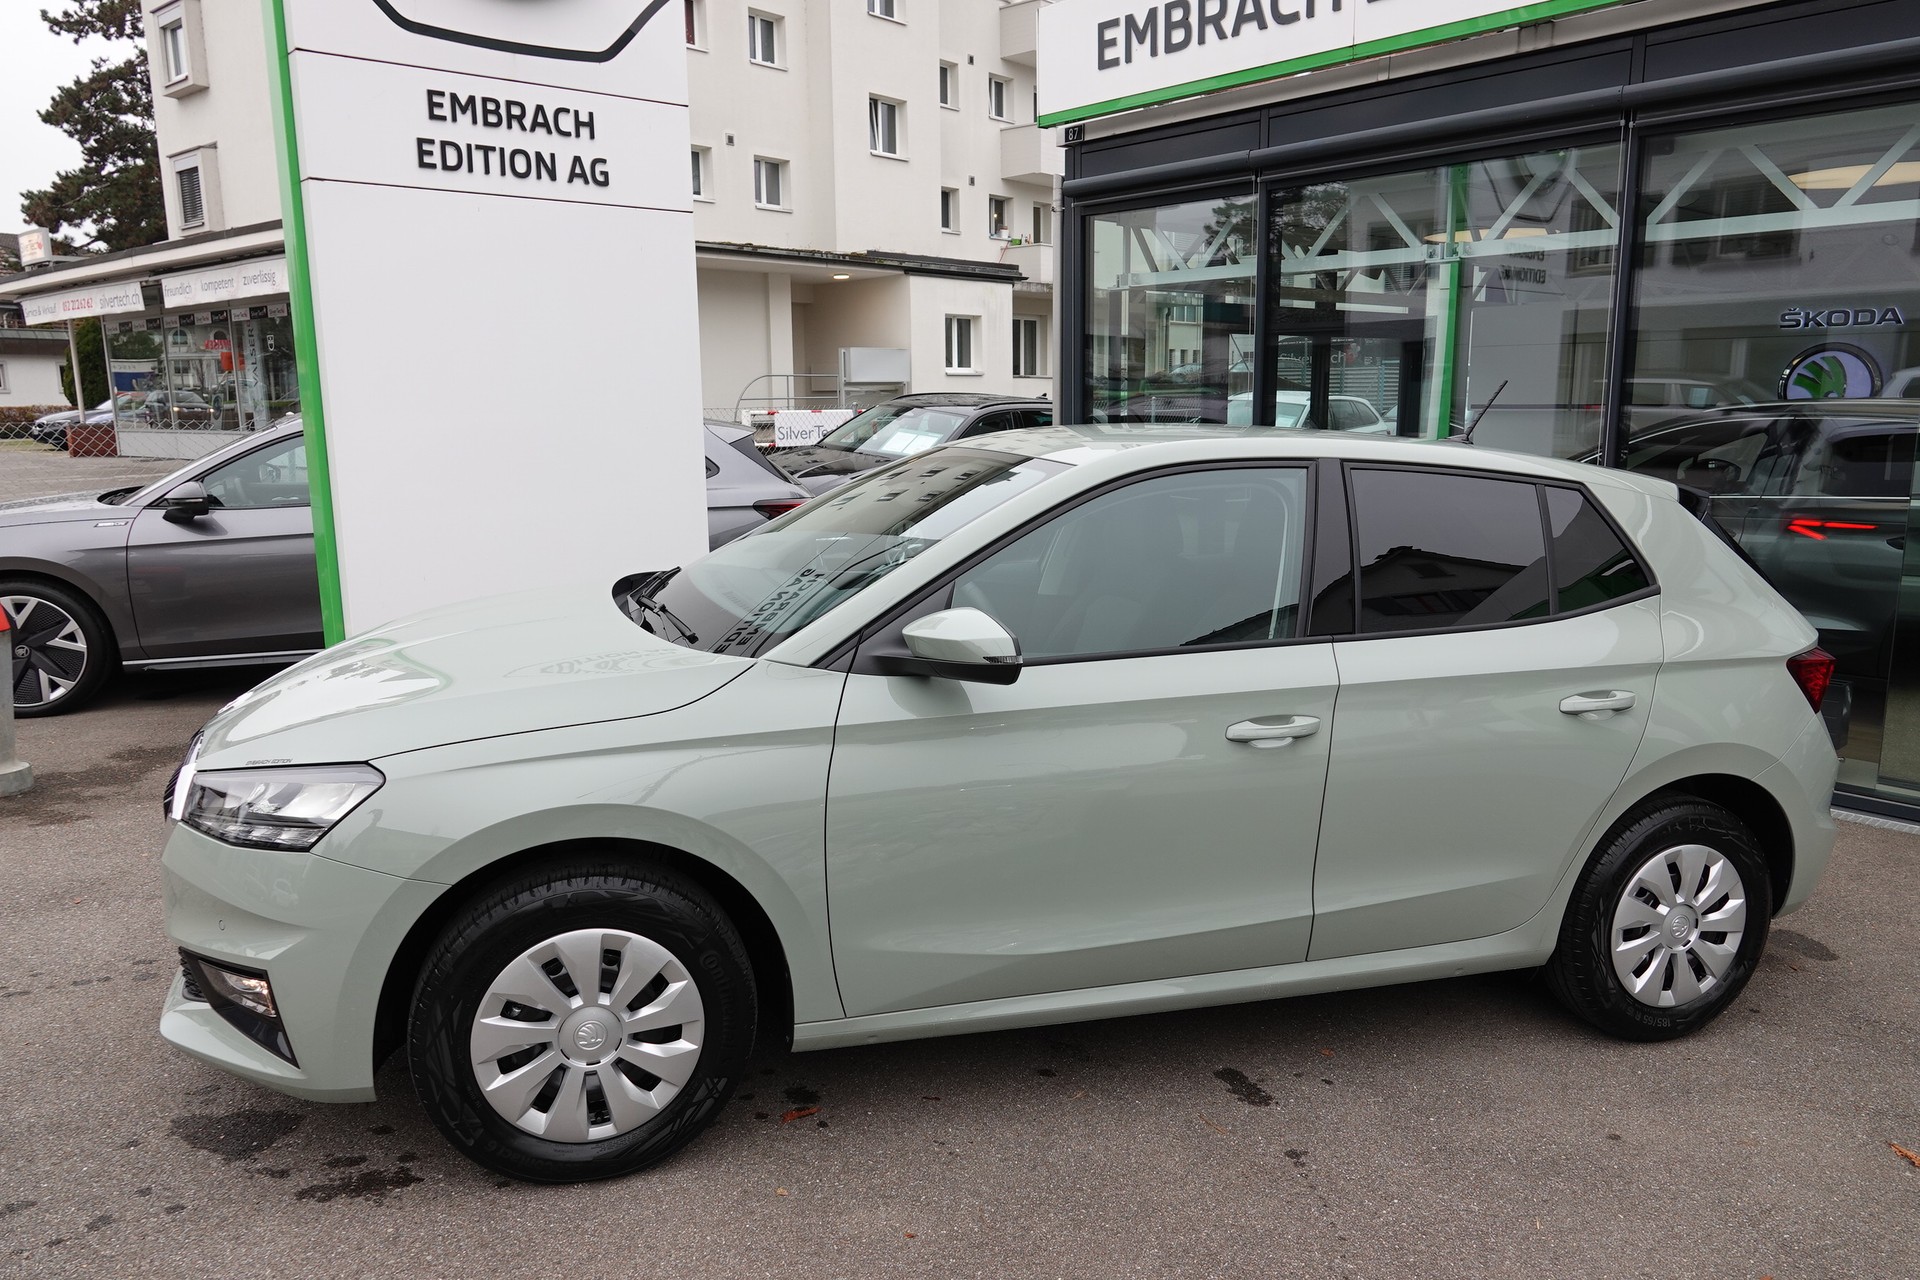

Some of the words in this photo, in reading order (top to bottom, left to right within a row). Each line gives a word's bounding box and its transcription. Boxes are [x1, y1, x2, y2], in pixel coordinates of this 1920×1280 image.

[427, 89, 595, 140] EMBRACH
[1068, 127, 1079, 140] 87
[416, 137, 557, 181] EDITION
[567, 155, 610, 187] AG
[164, 283, 192, 297] freundlich
[201, 277, 234, 294] kompetent
[99, 288, 140, 310] silvertech.ch
[1780, 307, 1904, 329] ŠKODA
[248, 328, 259, 387] VALSER
[777, 424, 840, 440] SilverTe
